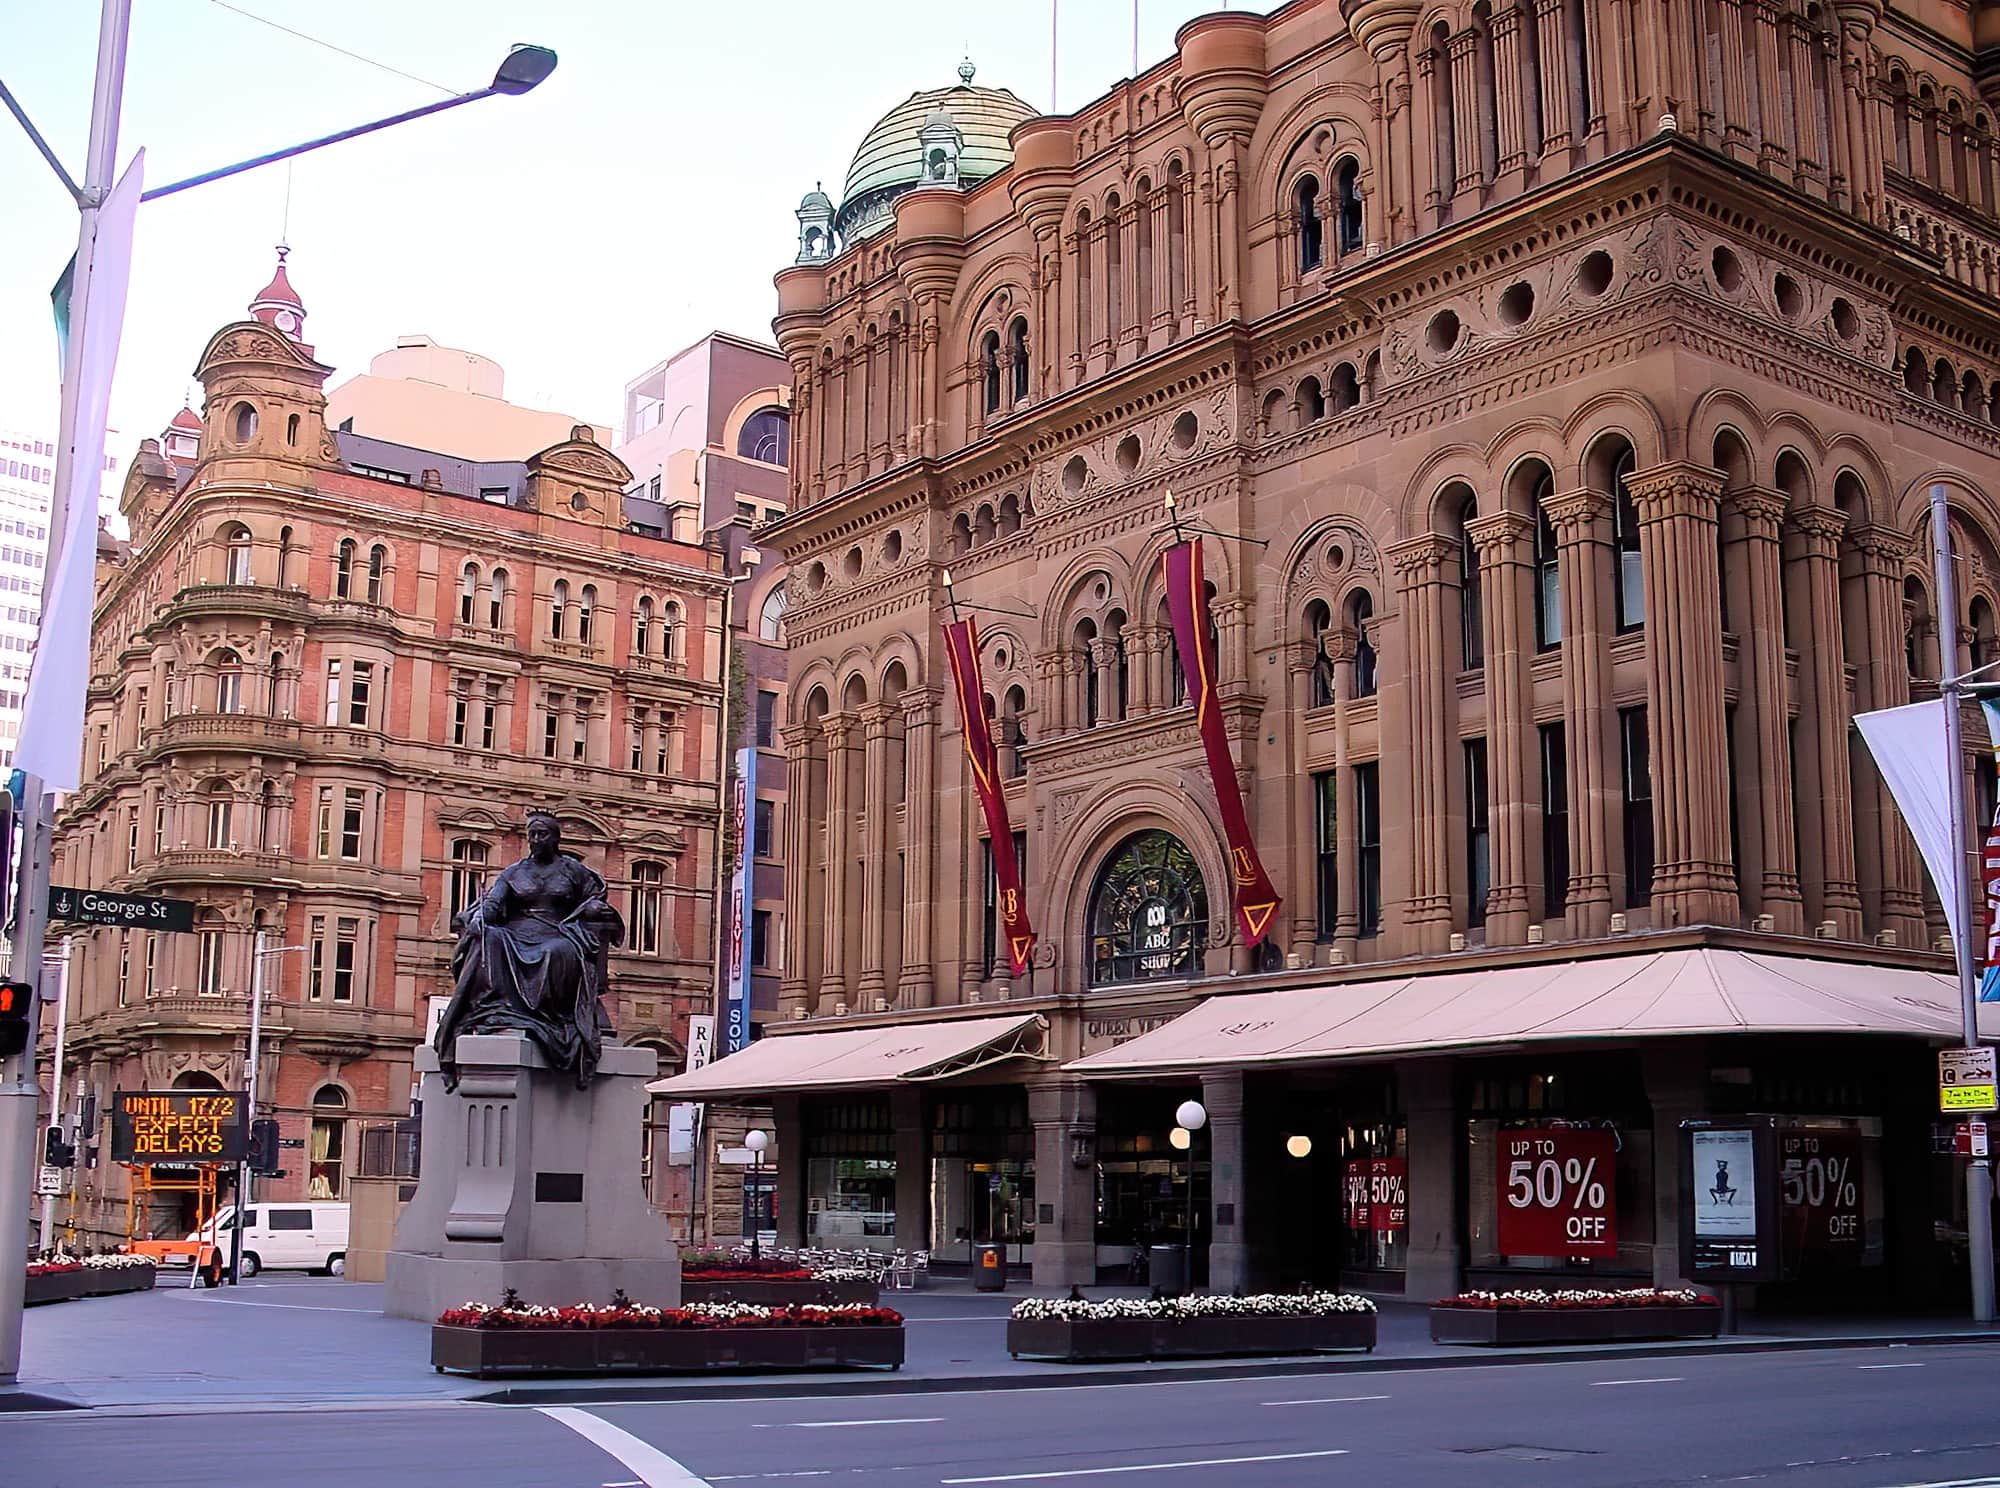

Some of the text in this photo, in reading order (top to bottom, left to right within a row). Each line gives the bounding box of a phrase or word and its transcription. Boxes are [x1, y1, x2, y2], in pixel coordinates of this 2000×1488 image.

[82, 894, 168, 919] George St
[1144, 934, 1170, 949] ABC
[1088, 1019, 1131, 1038] QUEEN
[125, 1097, 234, 1116] UNTIL 17/2
[135, 1116, 223, 1134] EXPECT
[134, 1135, 223, 1153] DELAYS
[1511, 1140, 1555, 1156] UP TO
[1785, 1138, 1819, 1153] UP TO
[1371, 1175, 1405, 1204] 50%
[1507, 1157, 1605, 1209] 50%
[1783, 1157, 1856, 1207] 50%
[1566, 1216, 1606, 1238] OFF
[1829, 1215, 1857, 1235] OFF
